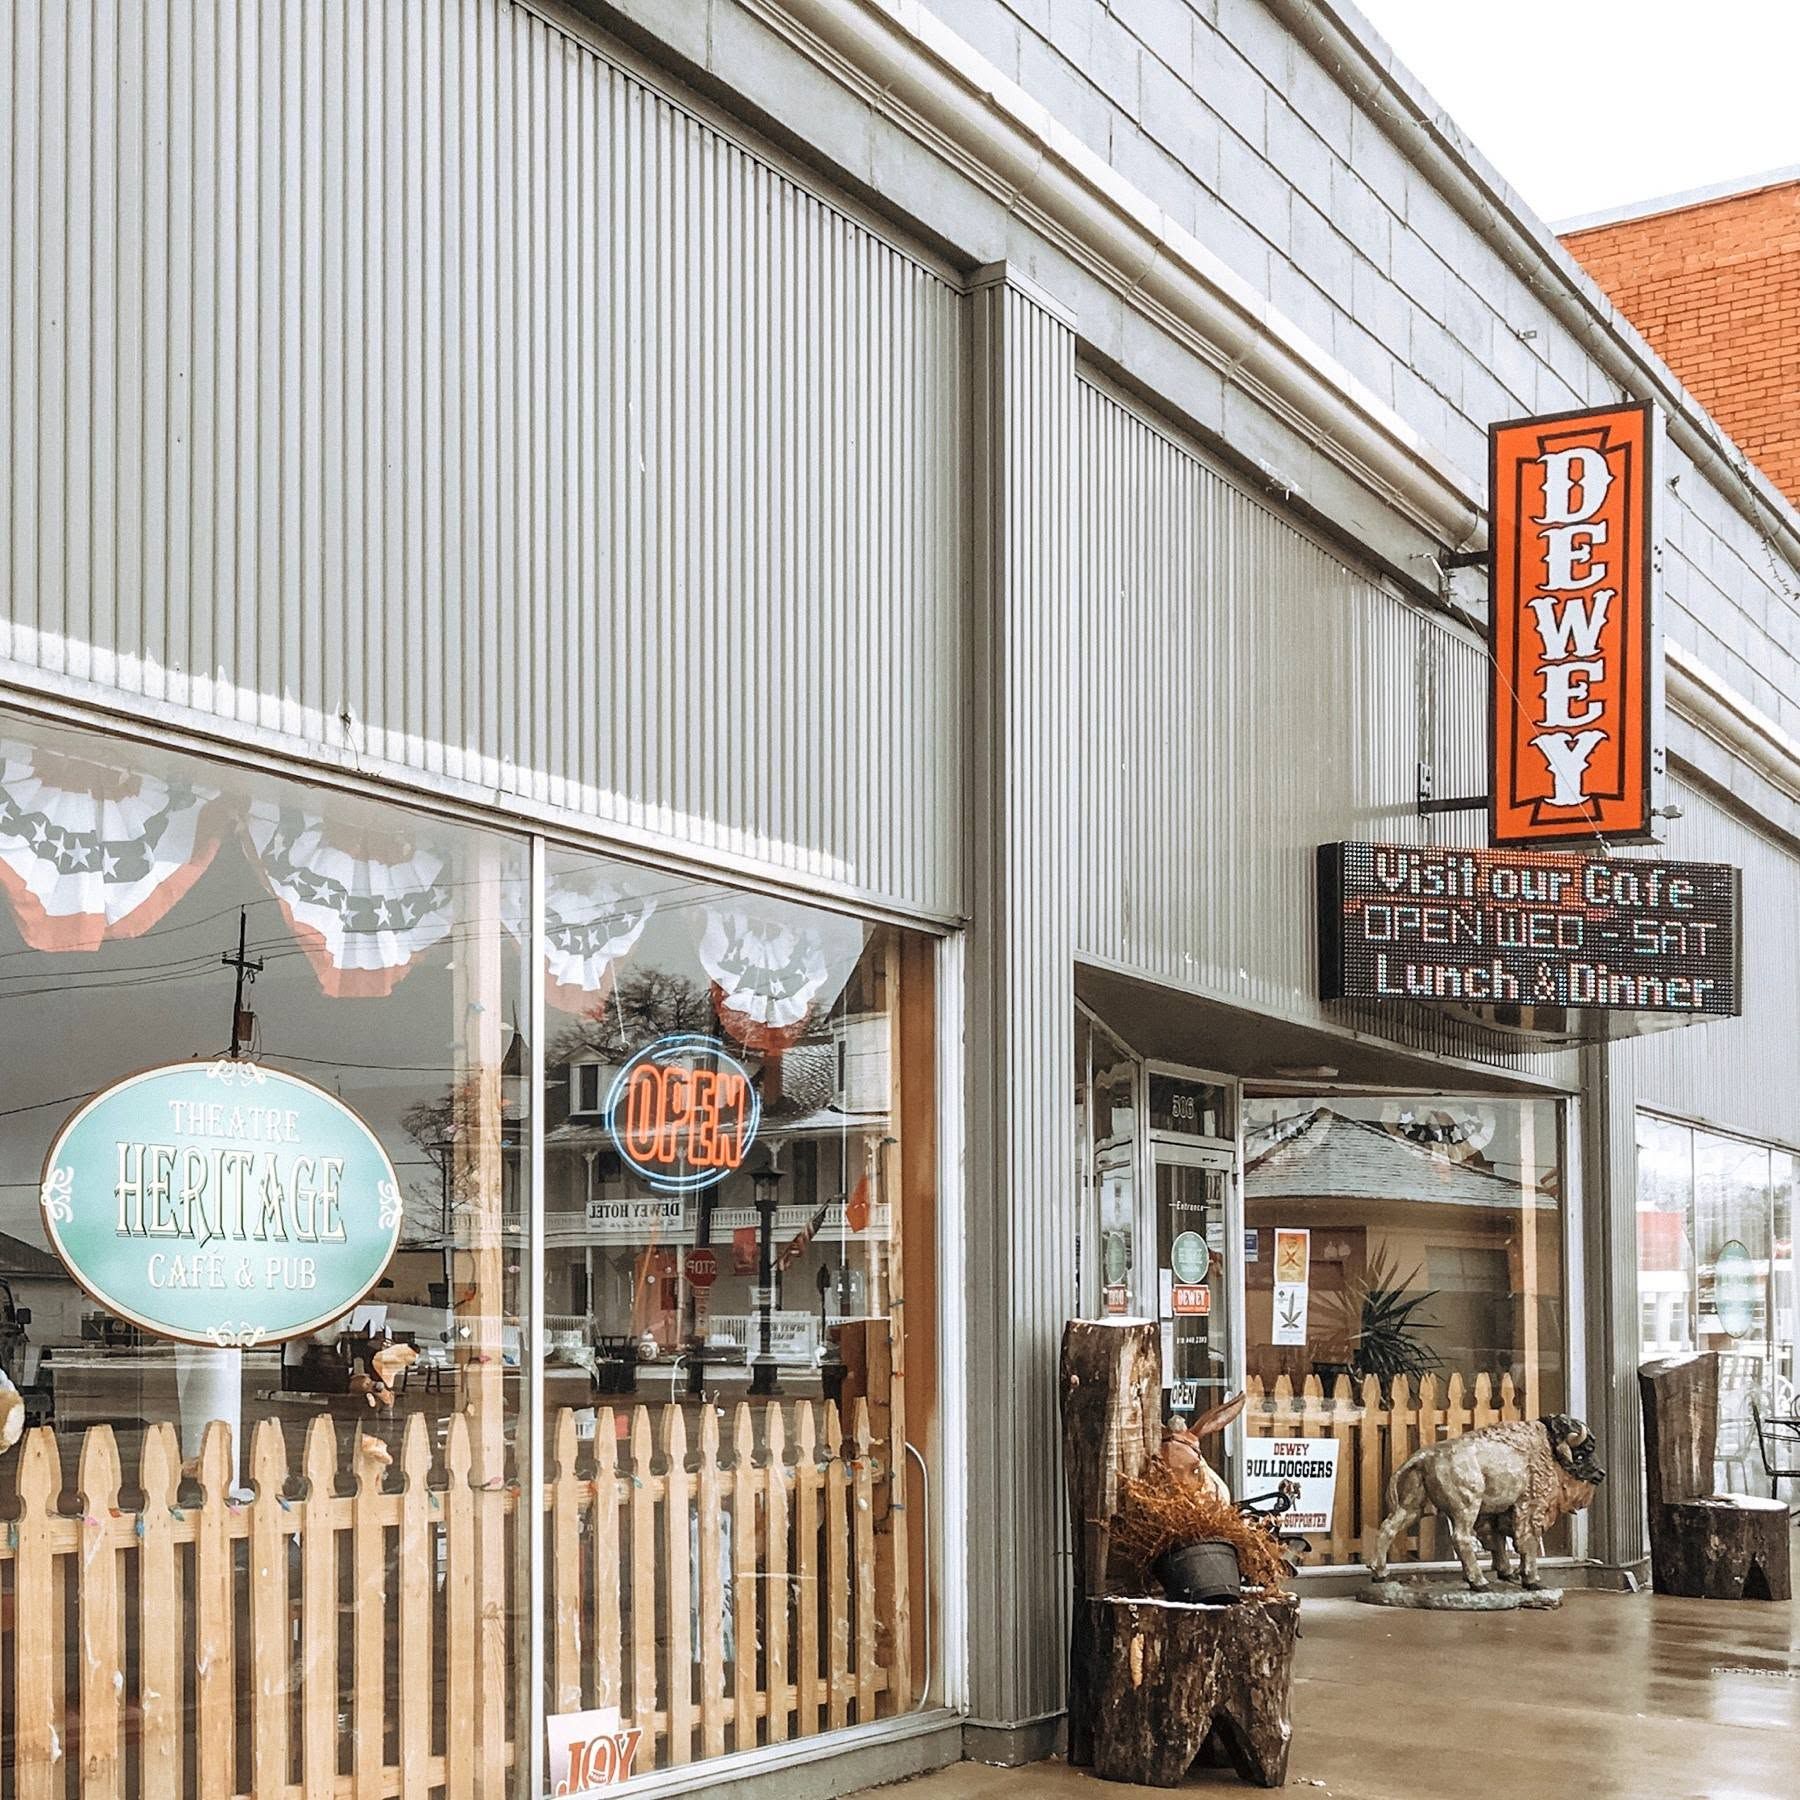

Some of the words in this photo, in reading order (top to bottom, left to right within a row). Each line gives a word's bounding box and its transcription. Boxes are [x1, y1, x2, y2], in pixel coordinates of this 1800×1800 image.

[1525, 446, 1617, 808] DEWEY
[1377, 852, 1477, 896] Visit
[1493, 869, 1571, 901] our
[1586, 865, 1694, 908] Cafe
[1365, 905, 1482, 945] OPEN
[1497, 911, 1584, 950] WED
[1633, 919, 1717, 955] SAT
[1377, 953, 1519, 999] Lunch
[1534, 961, 1556, 1001] &
[1570, 963, 1714, 1007] Dinner
[168, 1100, 301, 1144] THEATRE
[626, 1063, 745, 1169] OPEN
[114, 1141, 347, 1248] HERITAGE
[148, 1249, 226, 1289] CAFÉ
[237, 1257, 255, 1289] &
[265, 1257, 317, 1290] PUB
[1177, 1288, 1206, 1306] DEWEY
[1171, 1384, 1196, 1405] OPEN
[1247, 1459, 1333, 1478] BULLDOGGERS
[1273, 1443, 1309, 1456] DEWEY
[1284, 1513, 1327, 1528] SUPPORTER
[559, 1730, 641, 1795] JOY
